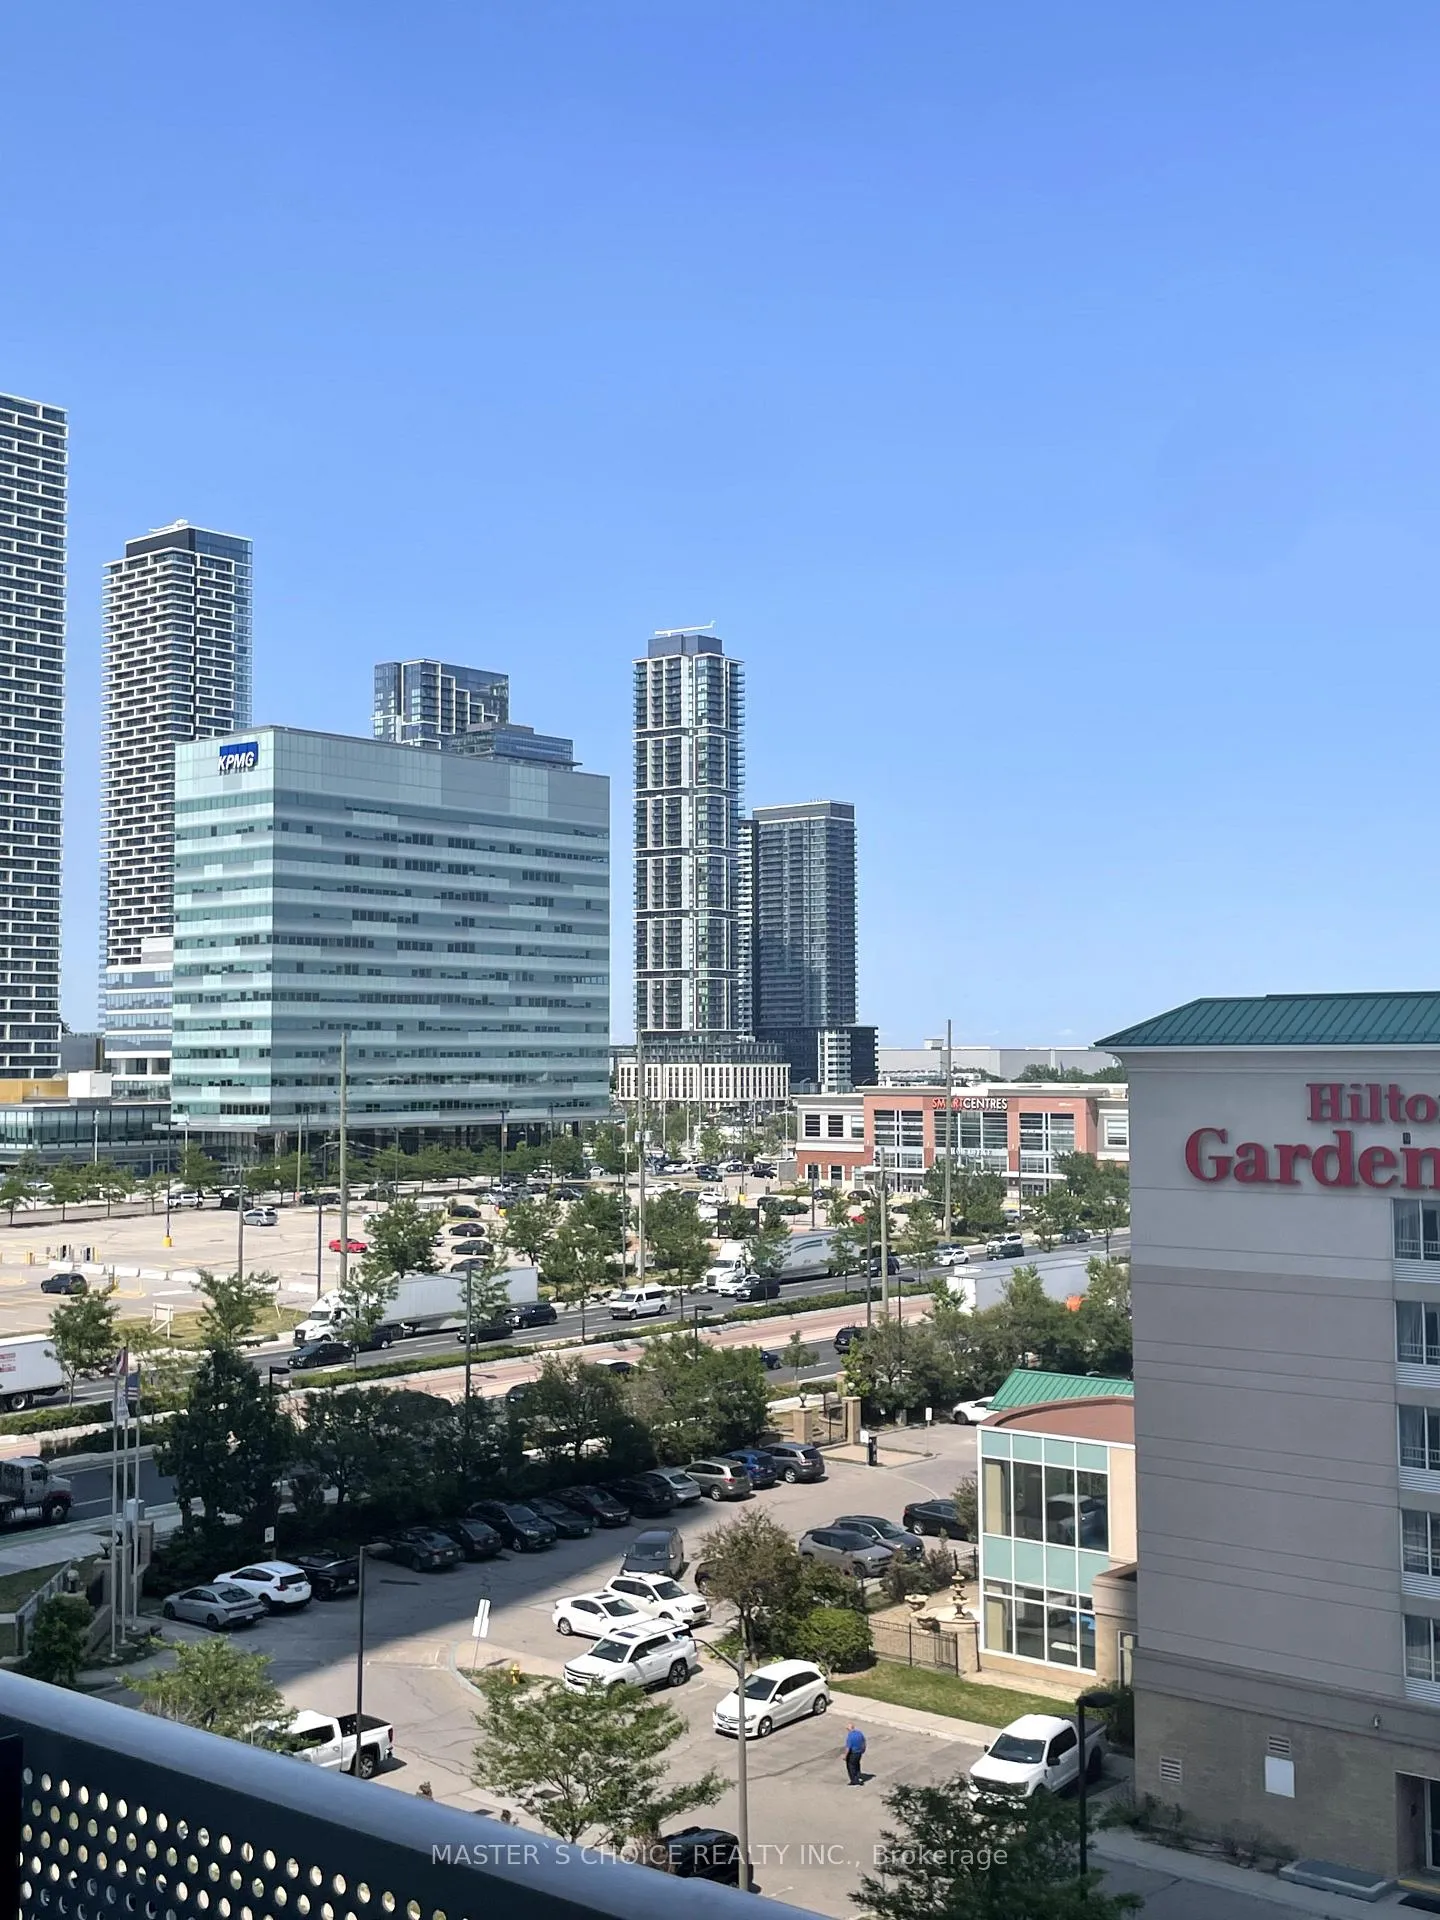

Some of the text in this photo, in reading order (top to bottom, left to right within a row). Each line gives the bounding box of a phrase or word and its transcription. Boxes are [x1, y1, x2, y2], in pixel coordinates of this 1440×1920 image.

[217, 751, 255, 770] KPMG
[932, 1097, 1008, 1110] SMRTCENTRES
[1306, 1082, 1440, 1124] Hilto
[1185, 1127, 1440, 1190] Garden
